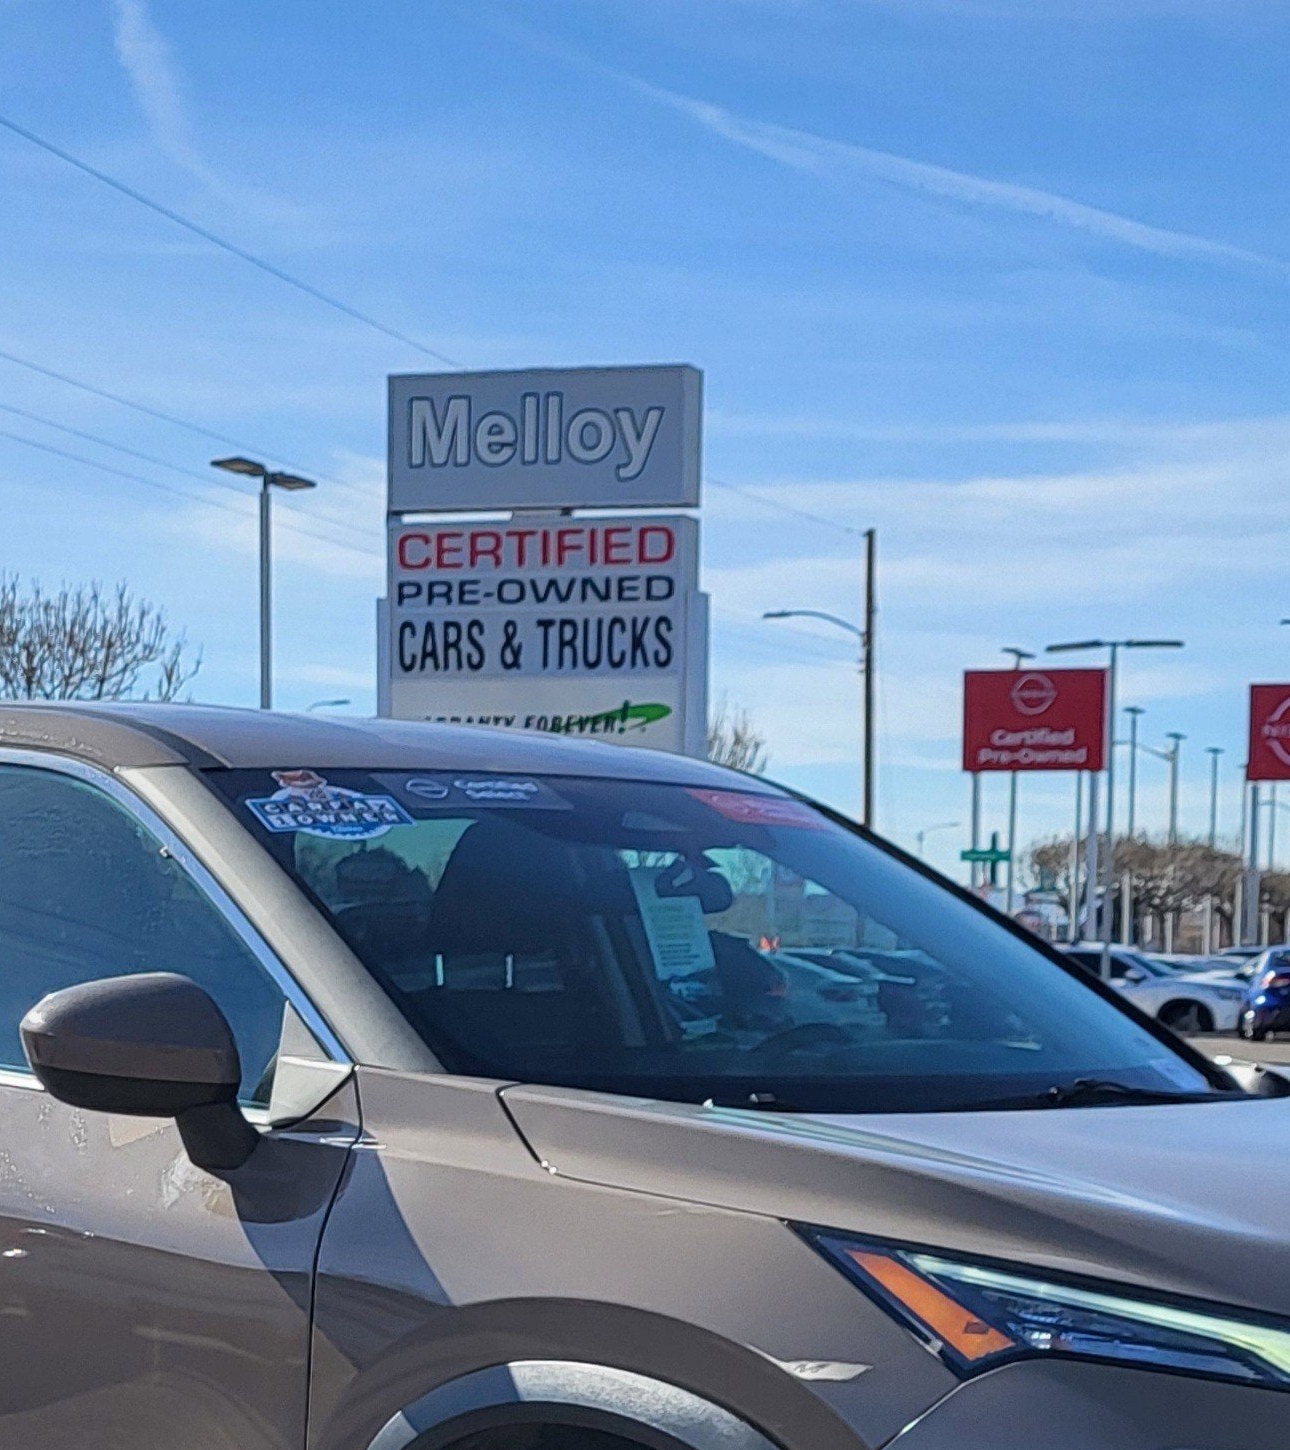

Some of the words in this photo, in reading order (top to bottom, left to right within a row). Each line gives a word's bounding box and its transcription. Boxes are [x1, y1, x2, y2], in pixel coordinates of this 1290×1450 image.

[407, 390, 665, 483] Melloy
[397, 525, 676, 571] CERTIFIED
[396, 574, 676, 607] PRE-OWNED
[398, 618, 487, 673] CARS
[499, 619, 524, 671] &
[536, 615, 674, 671] TRUCKS
